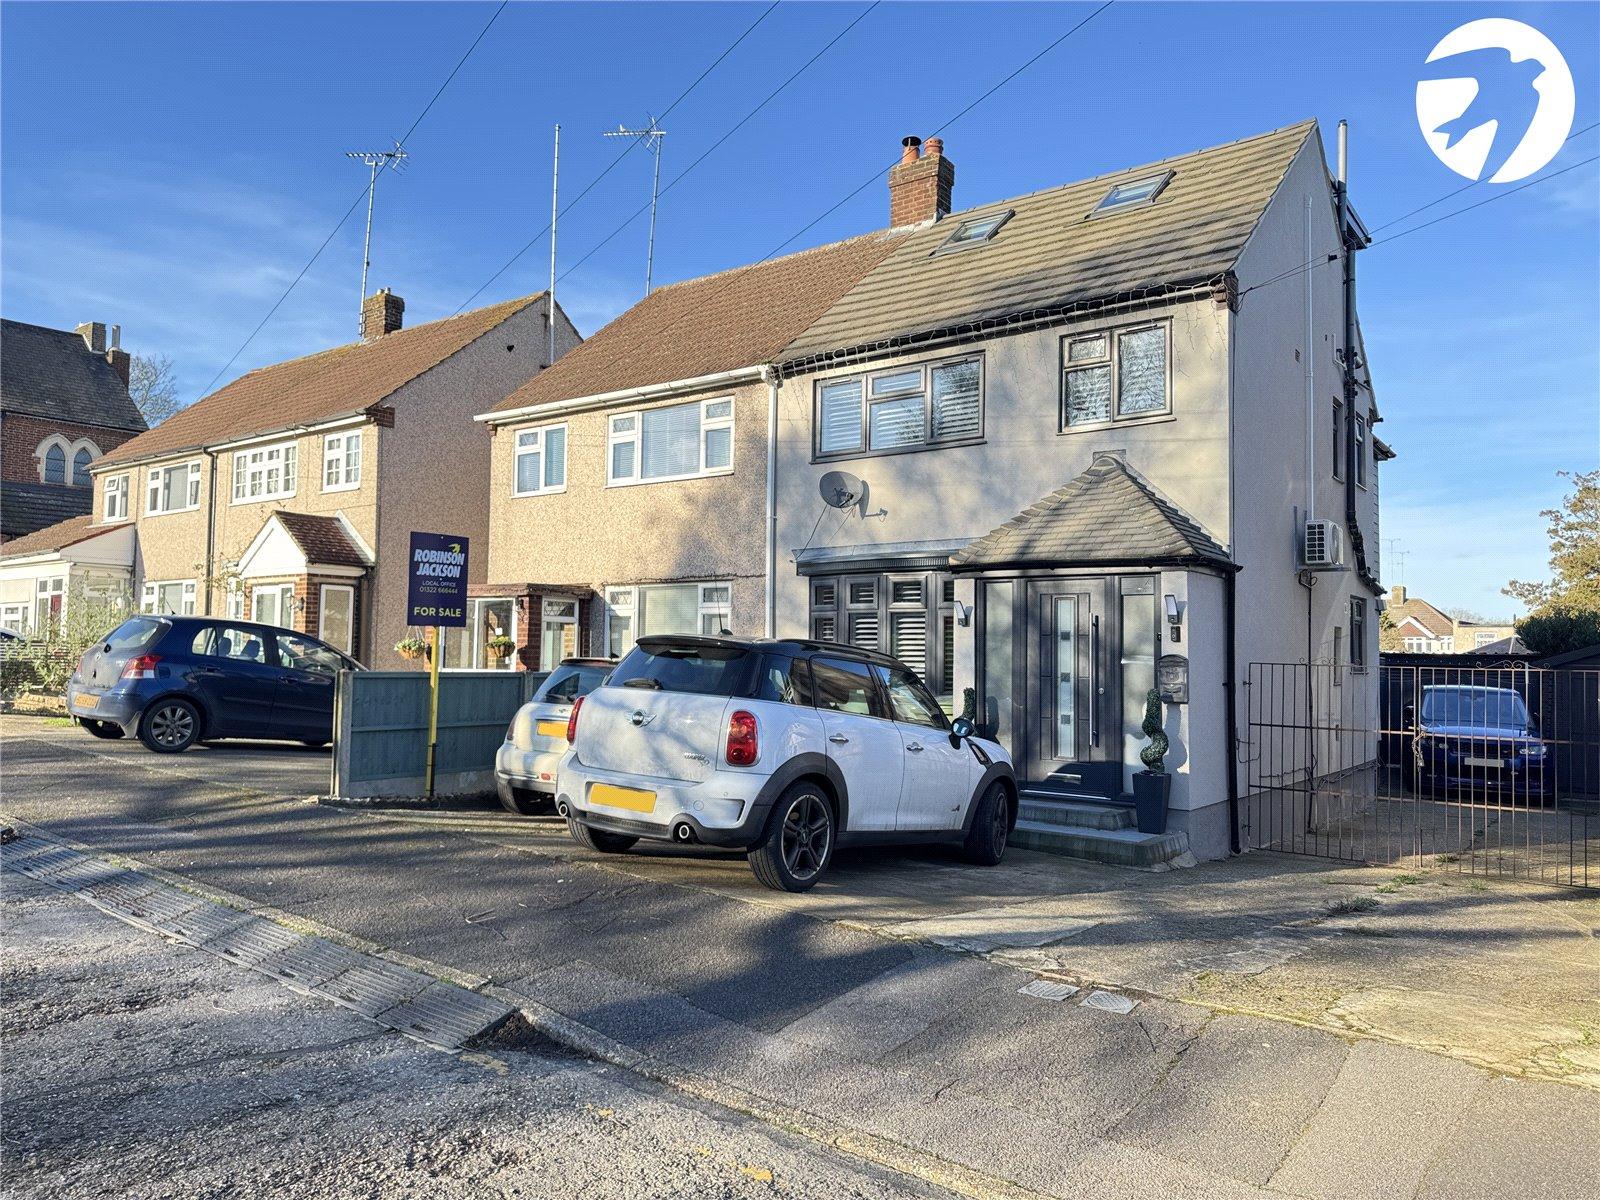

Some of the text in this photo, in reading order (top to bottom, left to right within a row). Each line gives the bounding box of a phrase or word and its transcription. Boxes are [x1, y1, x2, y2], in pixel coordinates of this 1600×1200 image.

[414, 549, 465, 566] ROBINSON
[416, 562, 461, 578] JACKSON
[414, 606, 461, 617] FOR SALE
